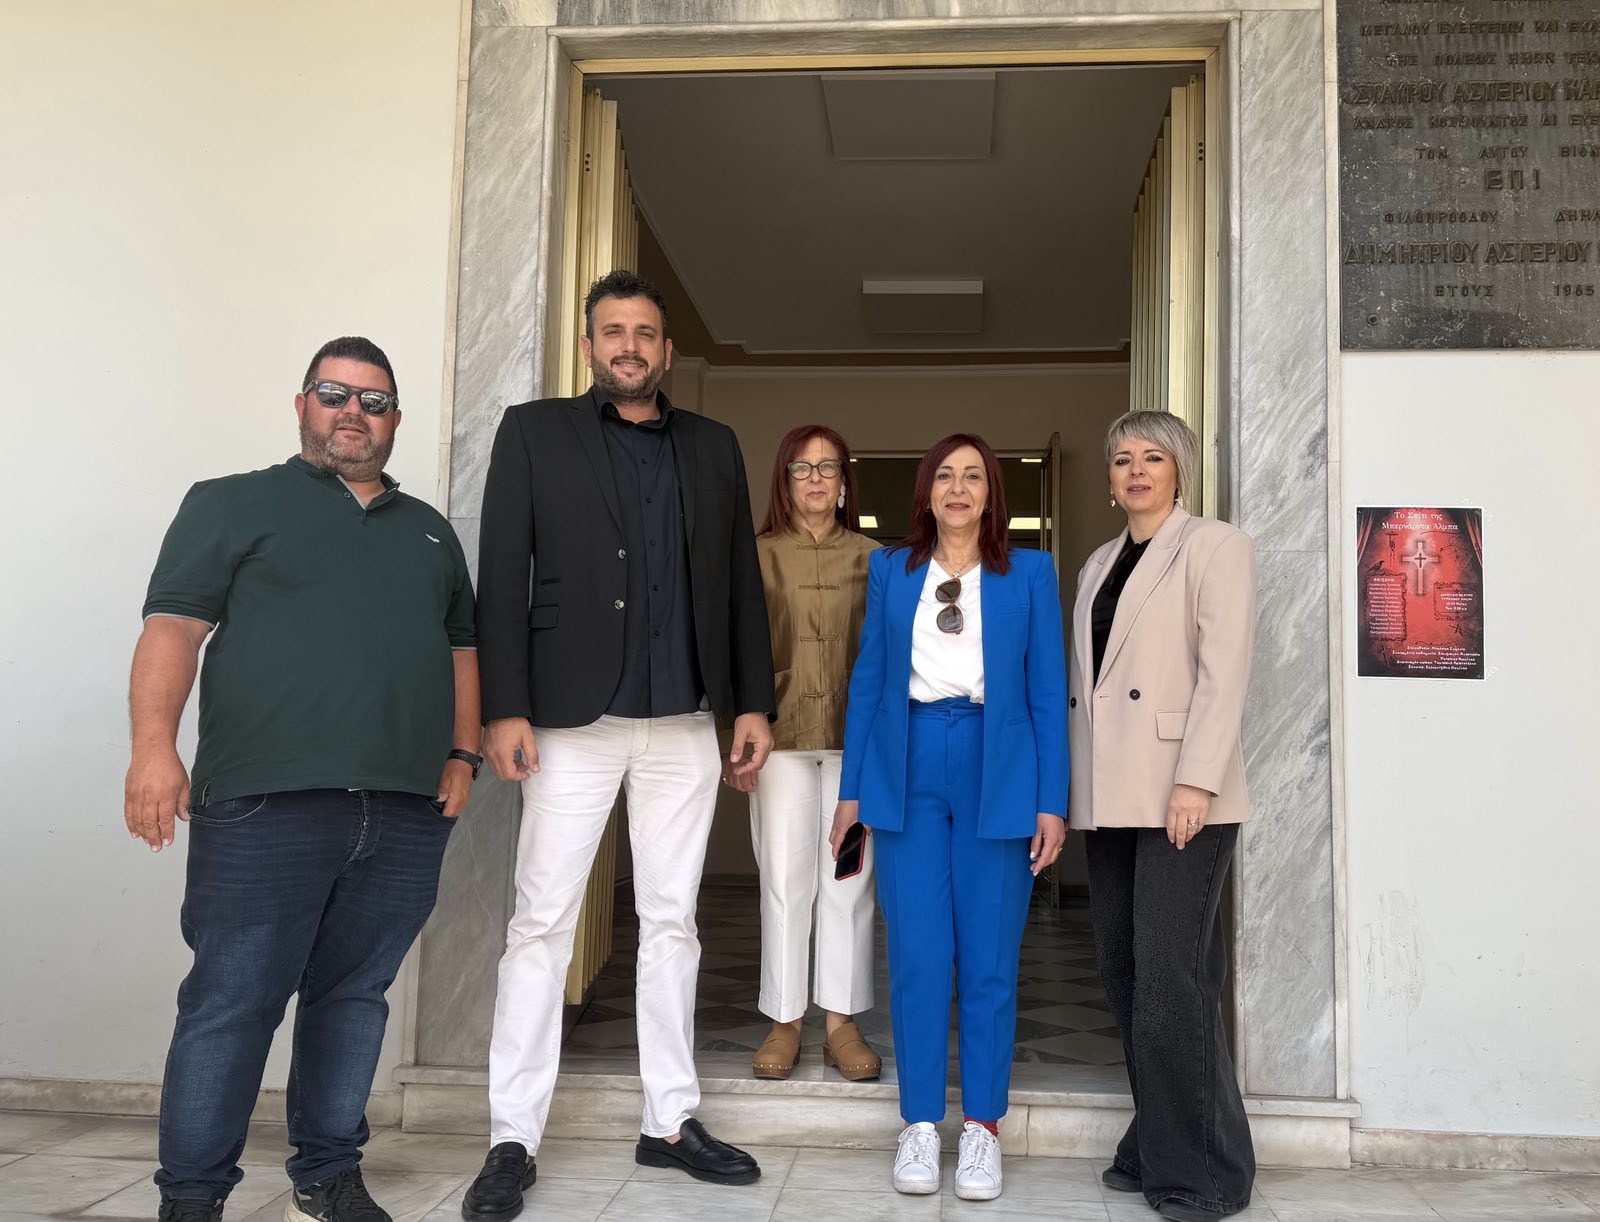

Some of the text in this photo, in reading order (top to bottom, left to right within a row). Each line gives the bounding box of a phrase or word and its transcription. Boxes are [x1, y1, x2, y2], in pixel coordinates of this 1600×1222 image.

[1360, 22, 1430, 36] ΜΕΓΑΛΟΥ
[1437, 20, 1525, 35] ΕΥΕΡΓΕΤΟΥ
[1533, 19, 1560, 33] ΚΑΙ
[1432, 51, 1497, 65] ΠΟΛΕΩΣ
[1353, 80, 1447, 105] ΣΤΑΥΡΟΥ
[1451, 79, 1559, 102] ΑΣΤΕΡΙΟΥ
[1354, 115, 1414, 129] ΑΝΔΡΟΣ
[1415, 147, 1449, 160] ΤΟΝ
[1478, 145, 1529, 159] ΑΥΤΟΥ
[1484, 166, 1541, 191] ΕΠΙ
[1383, 209, 1498, 224] ΦΙΛΟΠΡΟΟΔΟΥ
[1343, 241, 1480, 265] ΔΗΜΗΤΡΙΟΥ
[1485, 240, 1592, 264] ΑΣΤΕΡΙΟΥ
[1435, 284, 1595, 298] ΕΤΟΥΣ 1965
[1394, 511, 1405, 519] Το
